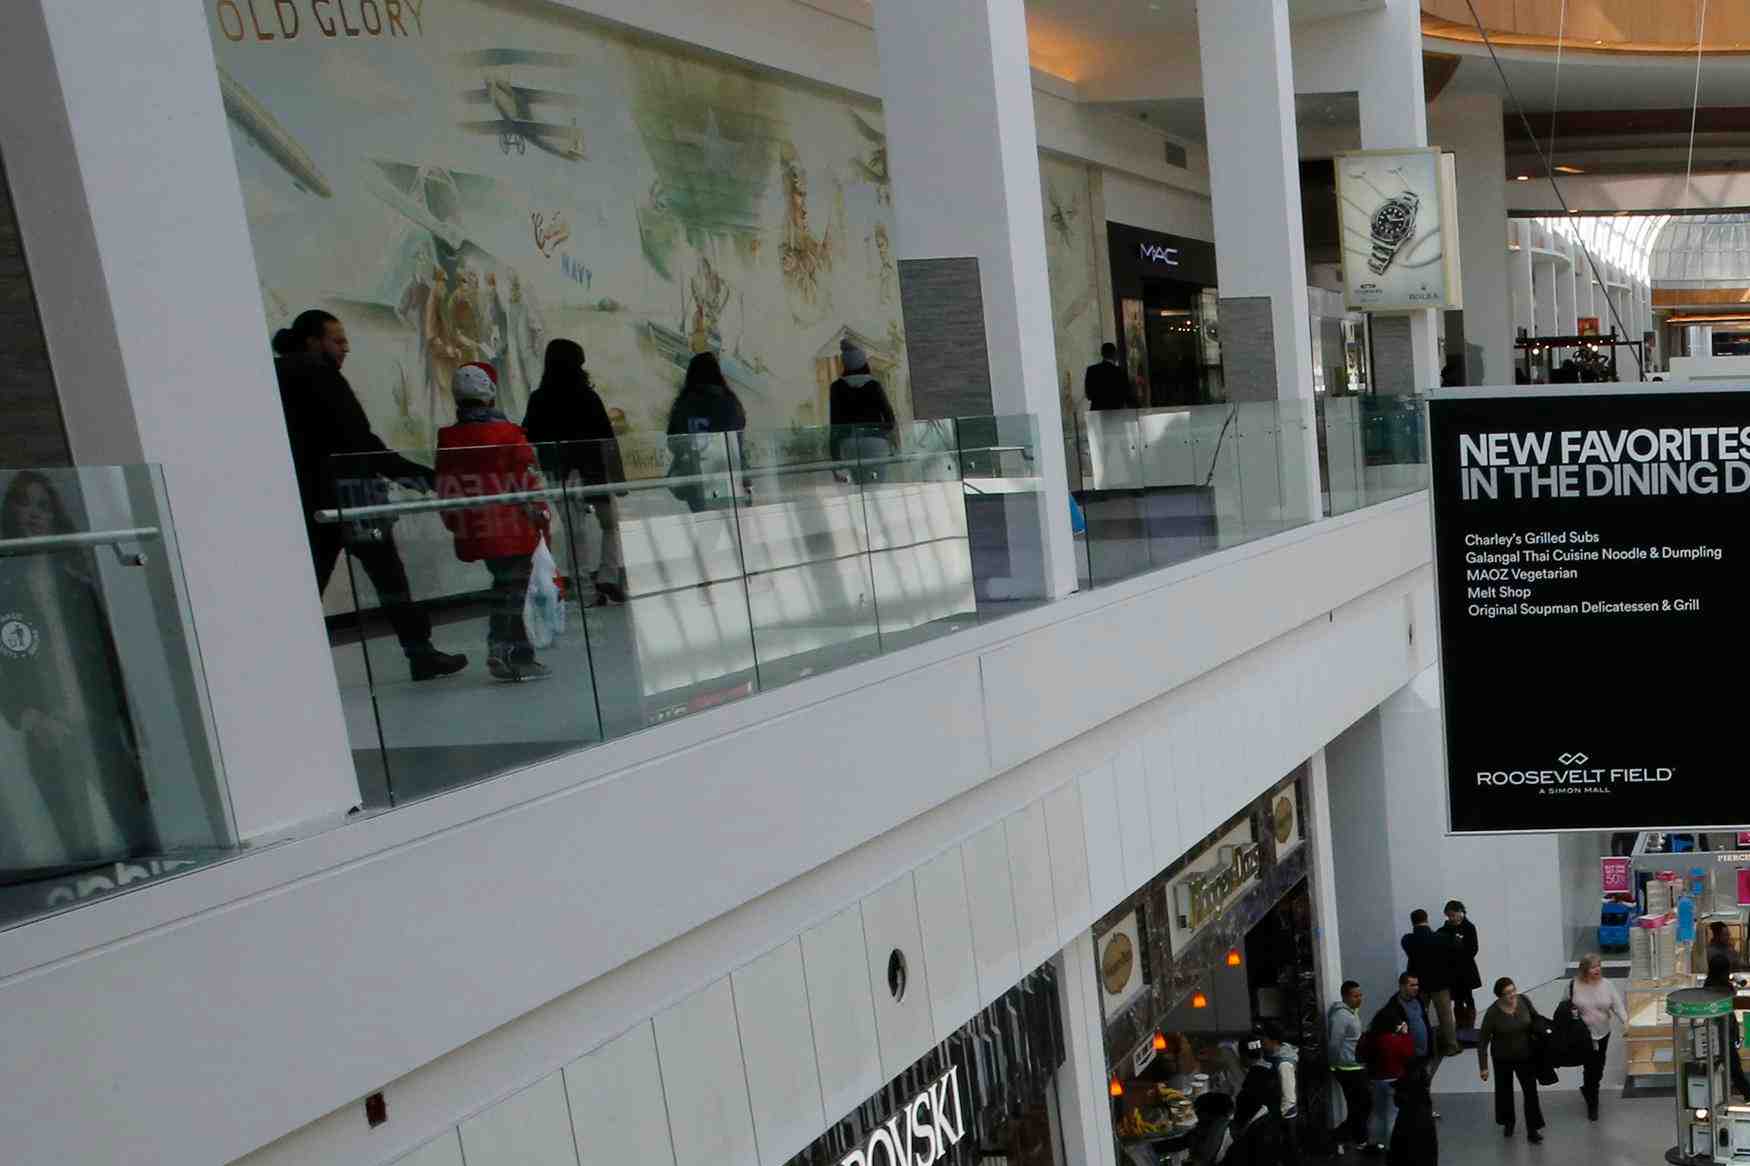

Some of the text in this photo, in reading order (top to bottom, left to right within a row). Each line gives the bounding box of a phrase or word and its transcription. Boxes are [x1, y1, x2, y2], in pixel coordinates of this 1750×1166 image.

[217, 0, 424, 41] OLD GLORY
[1458, 431, 1552, 467] NEW
[1461, 467, 1498, 500] IN
[1504, 466, 1580, 498] THE
[1586, 461, 1718, 496] DINING
[1465, 531, 1600, 547] Charley's Grilled Subs
[1465, 545, 1722, 565] Galangal Thai Cuisine Noodle & Dumpling
[1467, 566, 1578, 583] MAOZ Vegetarian
[1467, 586, 1532, 600] Melt Shop
[1468, 599, 1700, 618] Original Soupman Delicatessen & Grill
[1476, 768, 1673, 785] ROOSEVELT FIELD
[1549, 787, 1581, 795] SIMON
[1584, 786, 1611, 794] MALL
